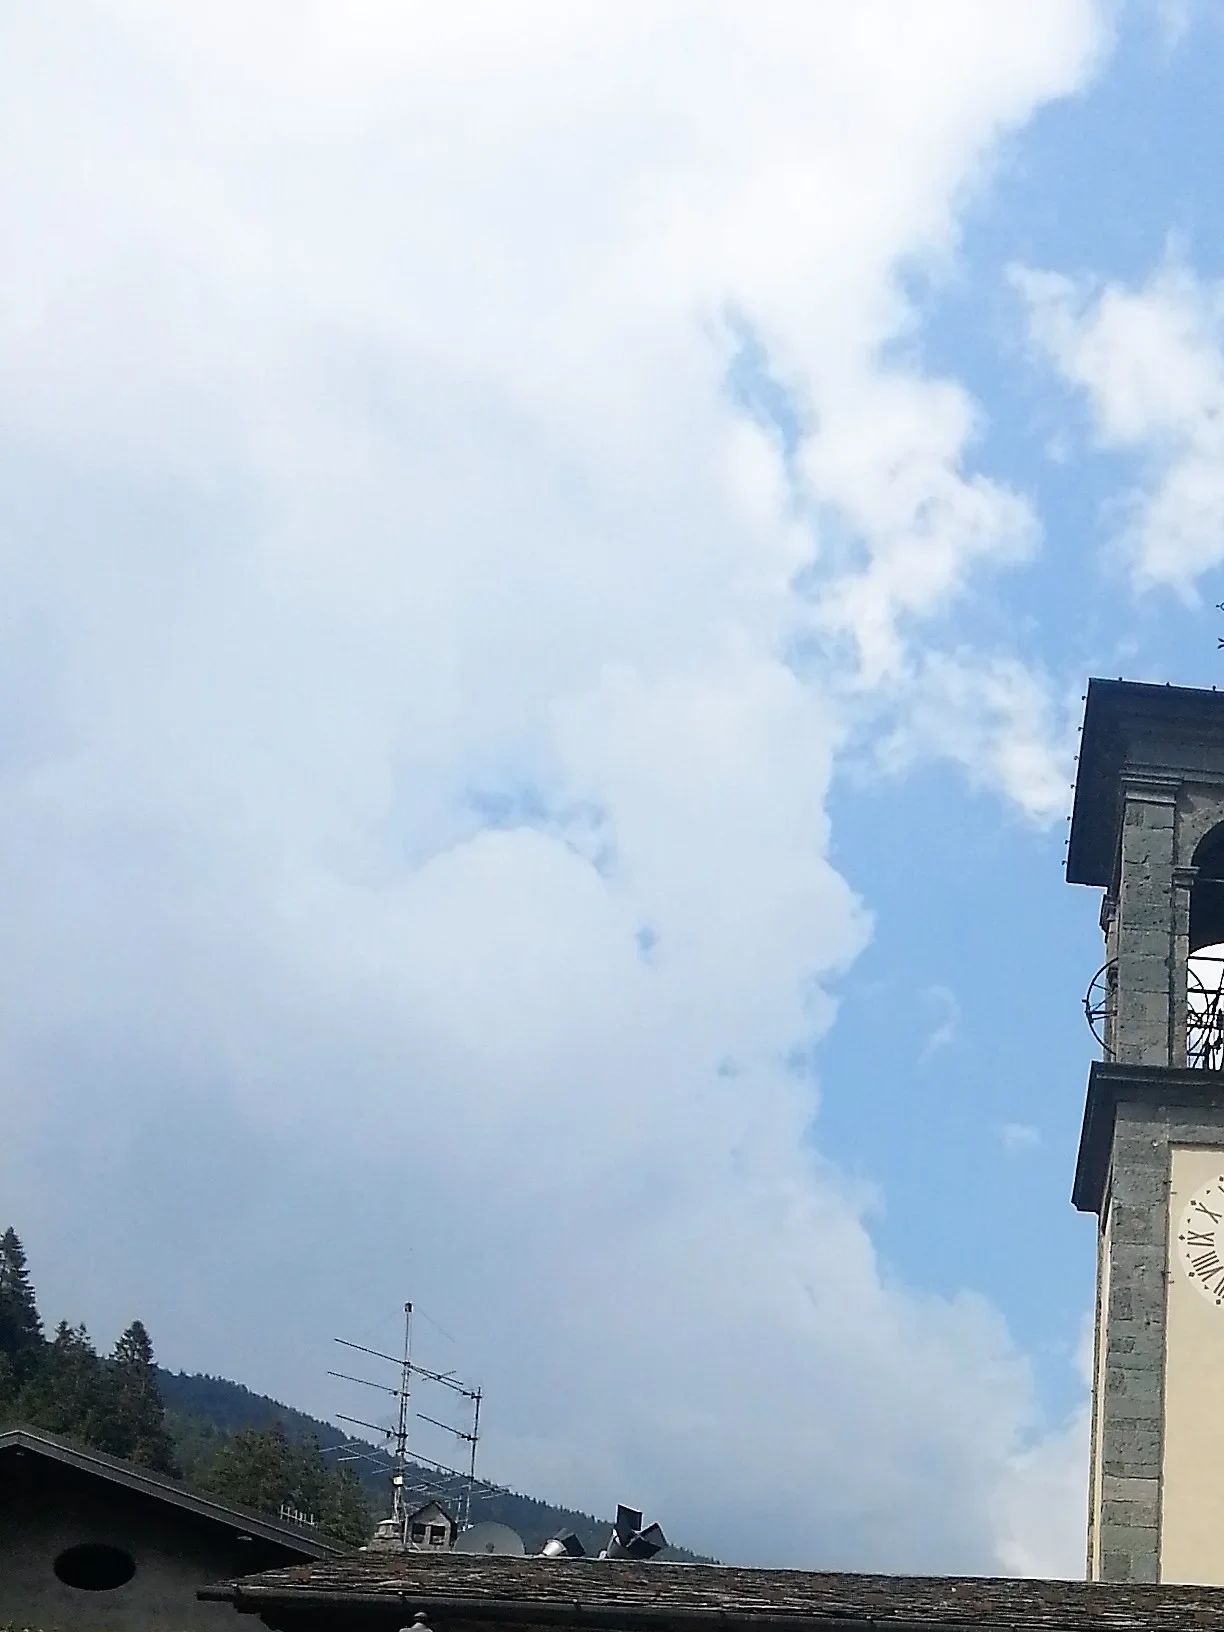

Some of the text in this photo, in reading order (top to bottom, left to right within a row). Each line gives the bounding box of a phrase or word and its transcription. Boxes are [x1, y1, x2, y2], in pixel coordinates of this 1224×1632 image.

[1195, 1202, 1222, 1224] X
[1187, 1230, 1215, 1247] IX
[1191, 1250, 1224, 1282] VIII
